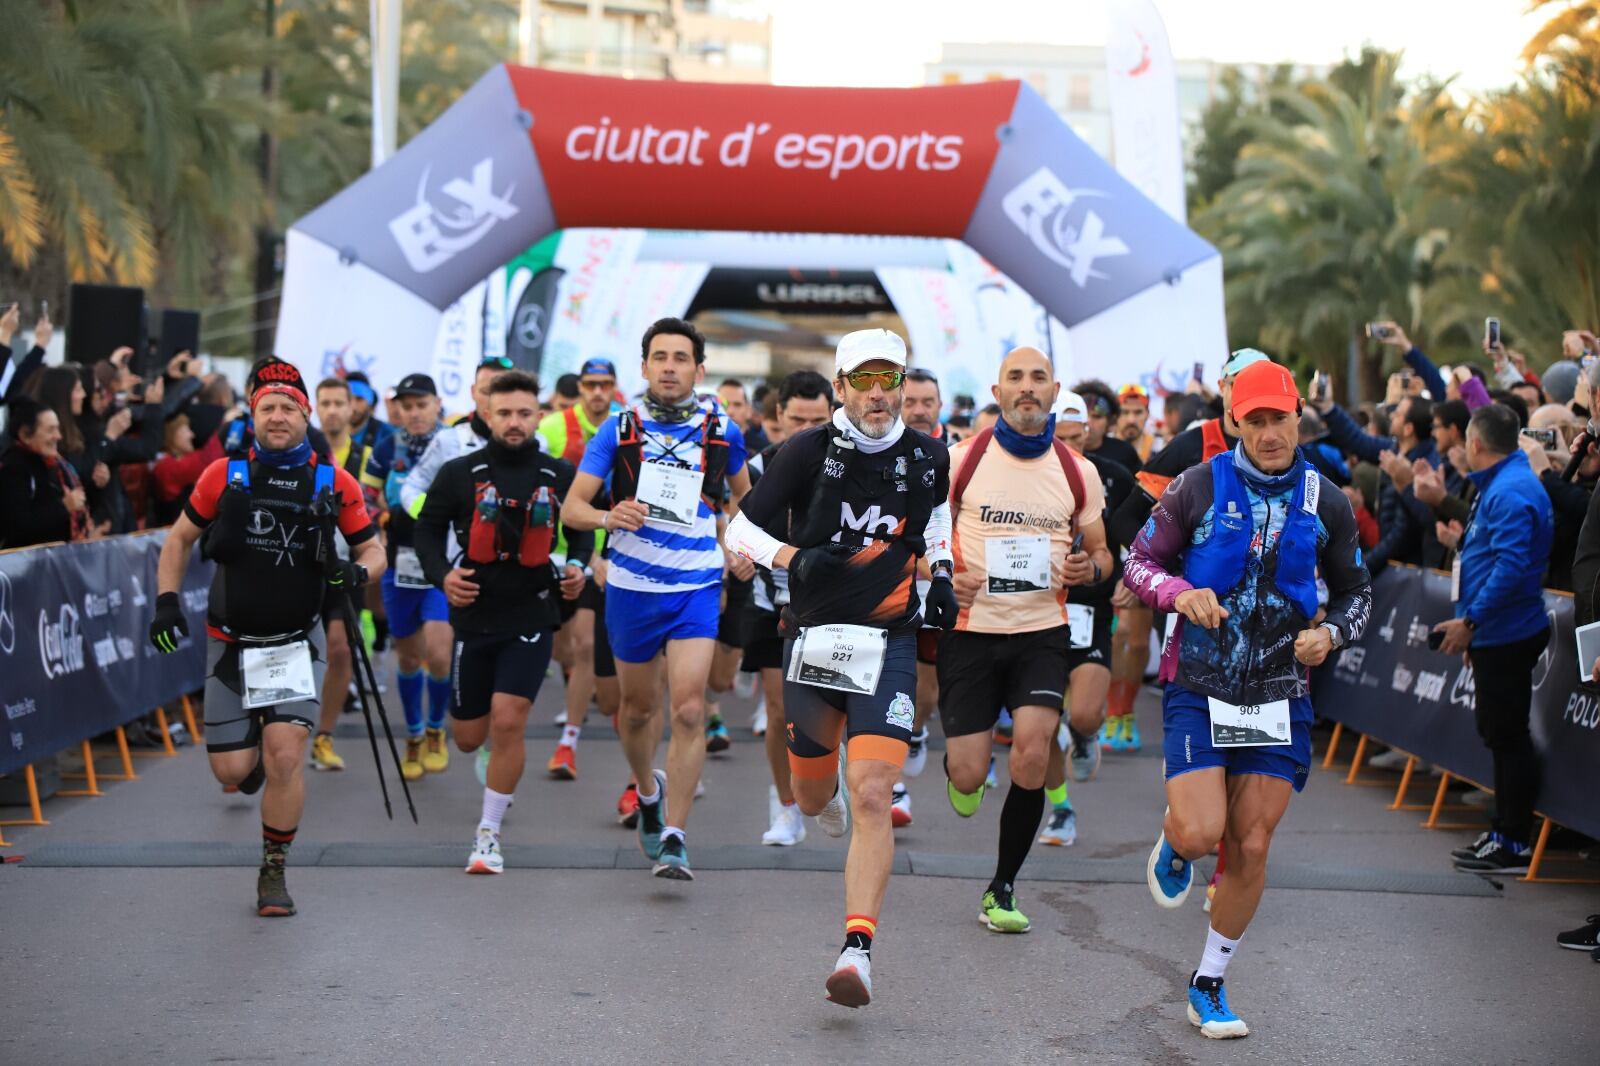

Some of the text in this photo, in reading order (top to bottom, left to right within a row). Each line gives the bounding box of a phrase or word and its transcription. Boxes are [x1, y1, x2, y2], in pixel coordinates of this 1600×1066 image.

[565, 116, 710, 166] ciutat
[774, 131, 964, 181] esports
[660, 489, 678, 500] 222
[1010, 560, 1029, 570] 402
[832, 642, 854, 652] KIKO
[831, 652, 853, 662] 921
[1239, 704, 1260, 715] 903
